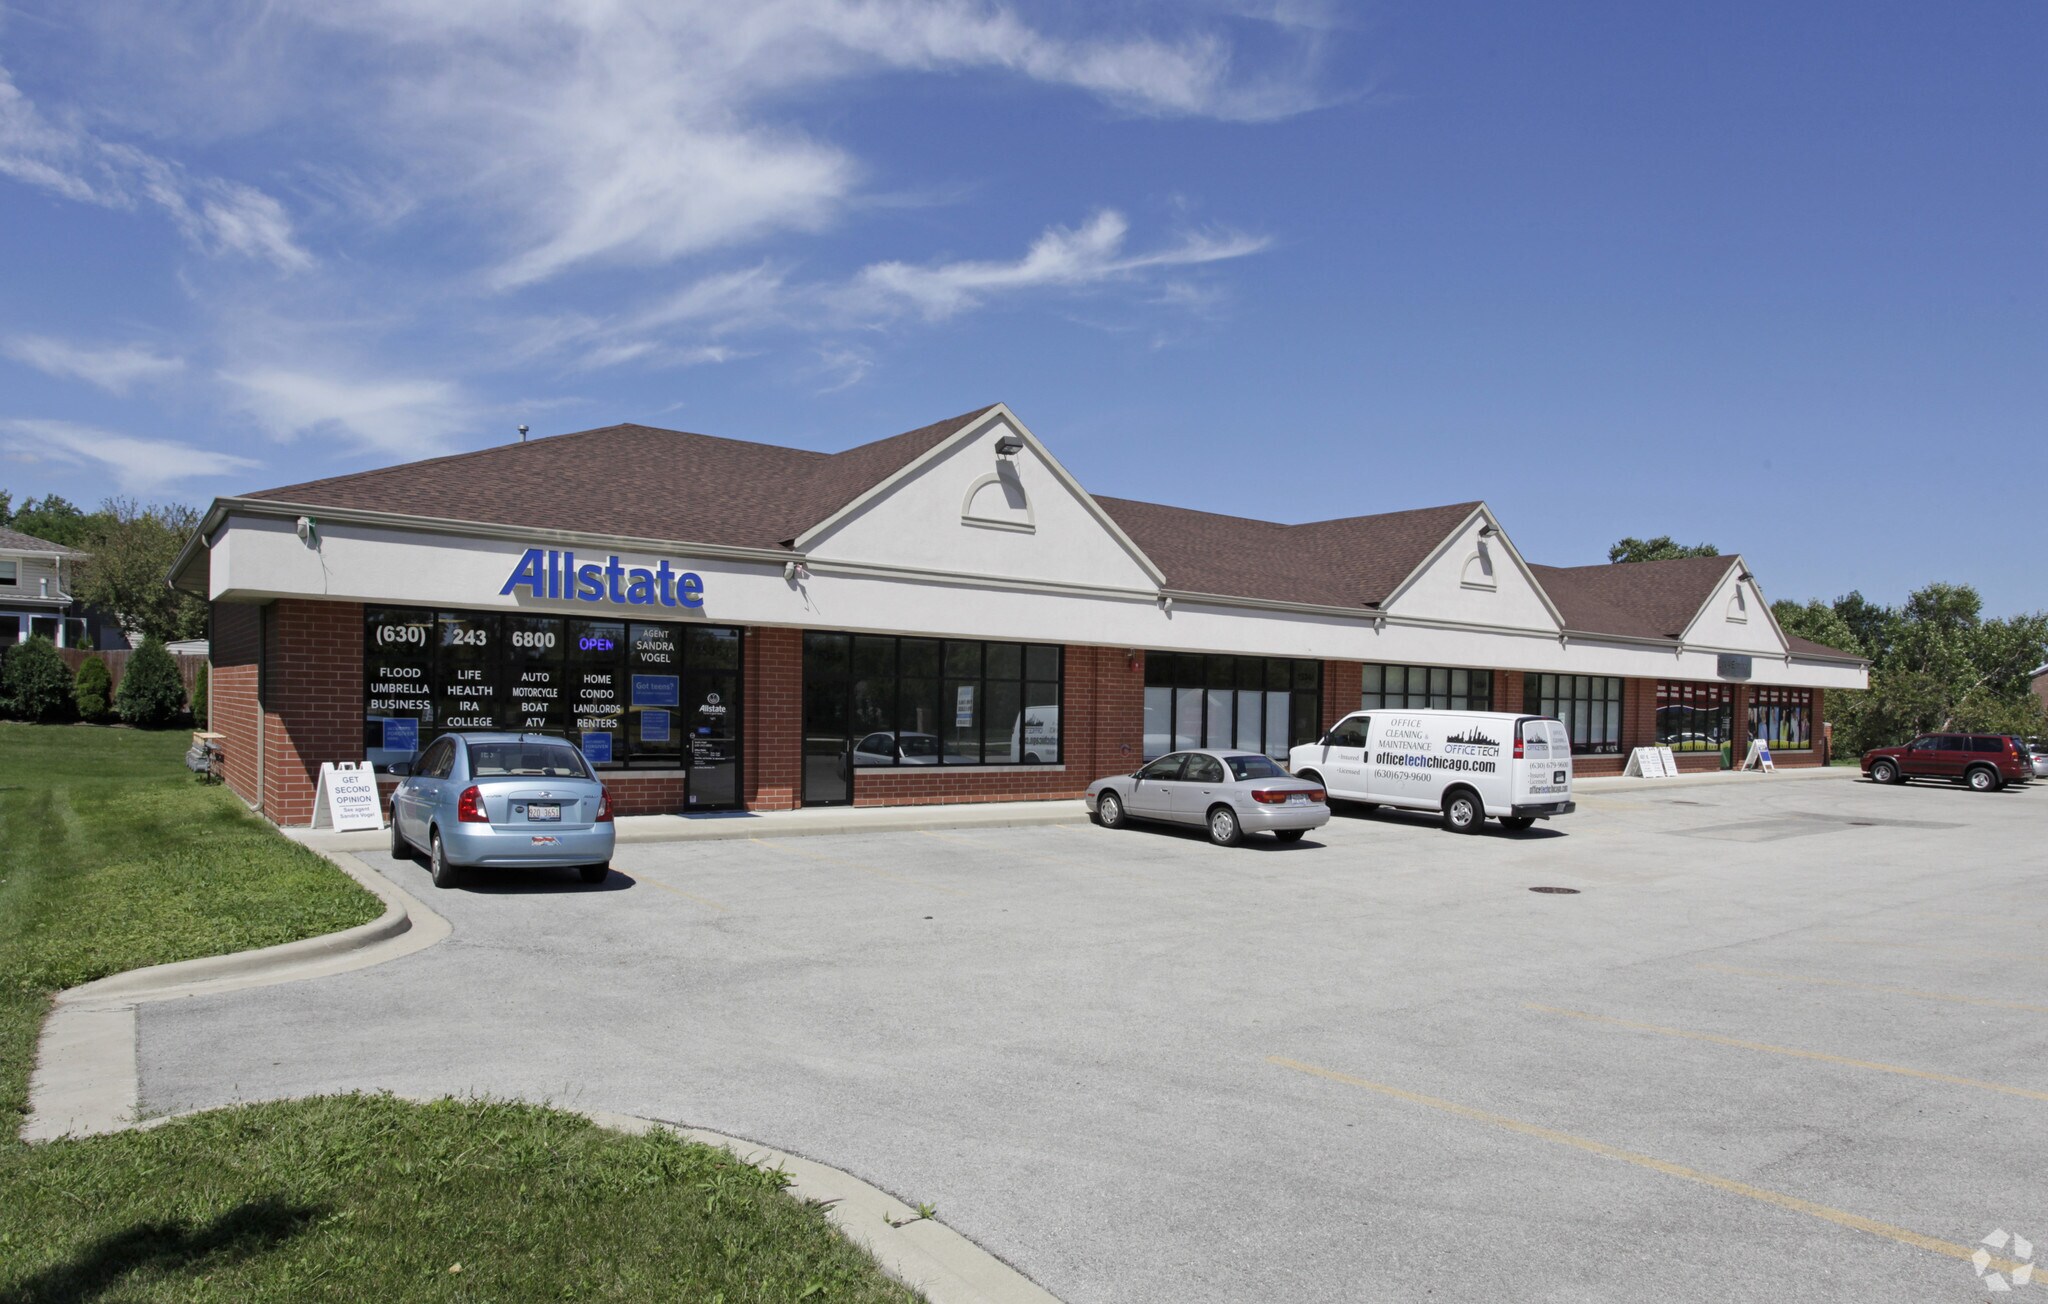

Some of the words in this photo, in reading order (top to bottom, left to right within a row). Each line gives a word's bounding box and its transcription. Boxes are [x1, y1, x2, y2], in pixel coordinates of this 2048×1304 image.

[498, 548, 705, 609] Allstate
[376, 625, 426, 647] (630)
[453, 629, 487, 646] 243
[512, 631, 556, 648] 6800
[642, 629, 669, 639] AGENT
[579, 637, 614, 652] OPEN
[636, 640, 675, 652] SANDRA
[640, 652, 671, 663] VOGEL
[380, 667, 421, 678] FLOOD
[457, 670, 482, 680] LIFE
[521, 672, 550, 682] AUTO
[583, 674, 612, 684] HOME
[370, 683, 430, 694] UMBRELLA
[447, 685, 493, 696] HEALTH
[636, 681, 649, 690] Got
[651, 682, 675, 691] teens?
[512, 687, 558, 698] MOTORCYCLE
[580, 689, 614, 699] CONDO
[371, 699, 431, 710] BUSINESS
[460, 701, 480, 712] IRA
[521, 702, 549, 712] BOAT
[573, 704, 621, 714] LANDLORDS
[699, 704, 727, 713] Allstate
[446, 717, 493, 727] COLLEGE
[525, 717, 546, 727] ATV
[576, 718, 618, 728] RENTERS
[1390, 718, 1422, 728] OFFICE
[1385, 729, 1424, 740] CLEANING
[1378, 740, 1432, 751] MAINTENANCE
[1477, 746, 1500, 757] TECH
[1376, 751, 1496, 773] officetechchicago.com
[342, 776, 359, 784] GET
[1374, 771, 1432, 783] (630)679-9600
[335, 785, 370, 795] SECOND
[336, 795, 372, 804] OPINION
[529, 807, 541, 818] 920
[544, 807, 560, 818] 3651
